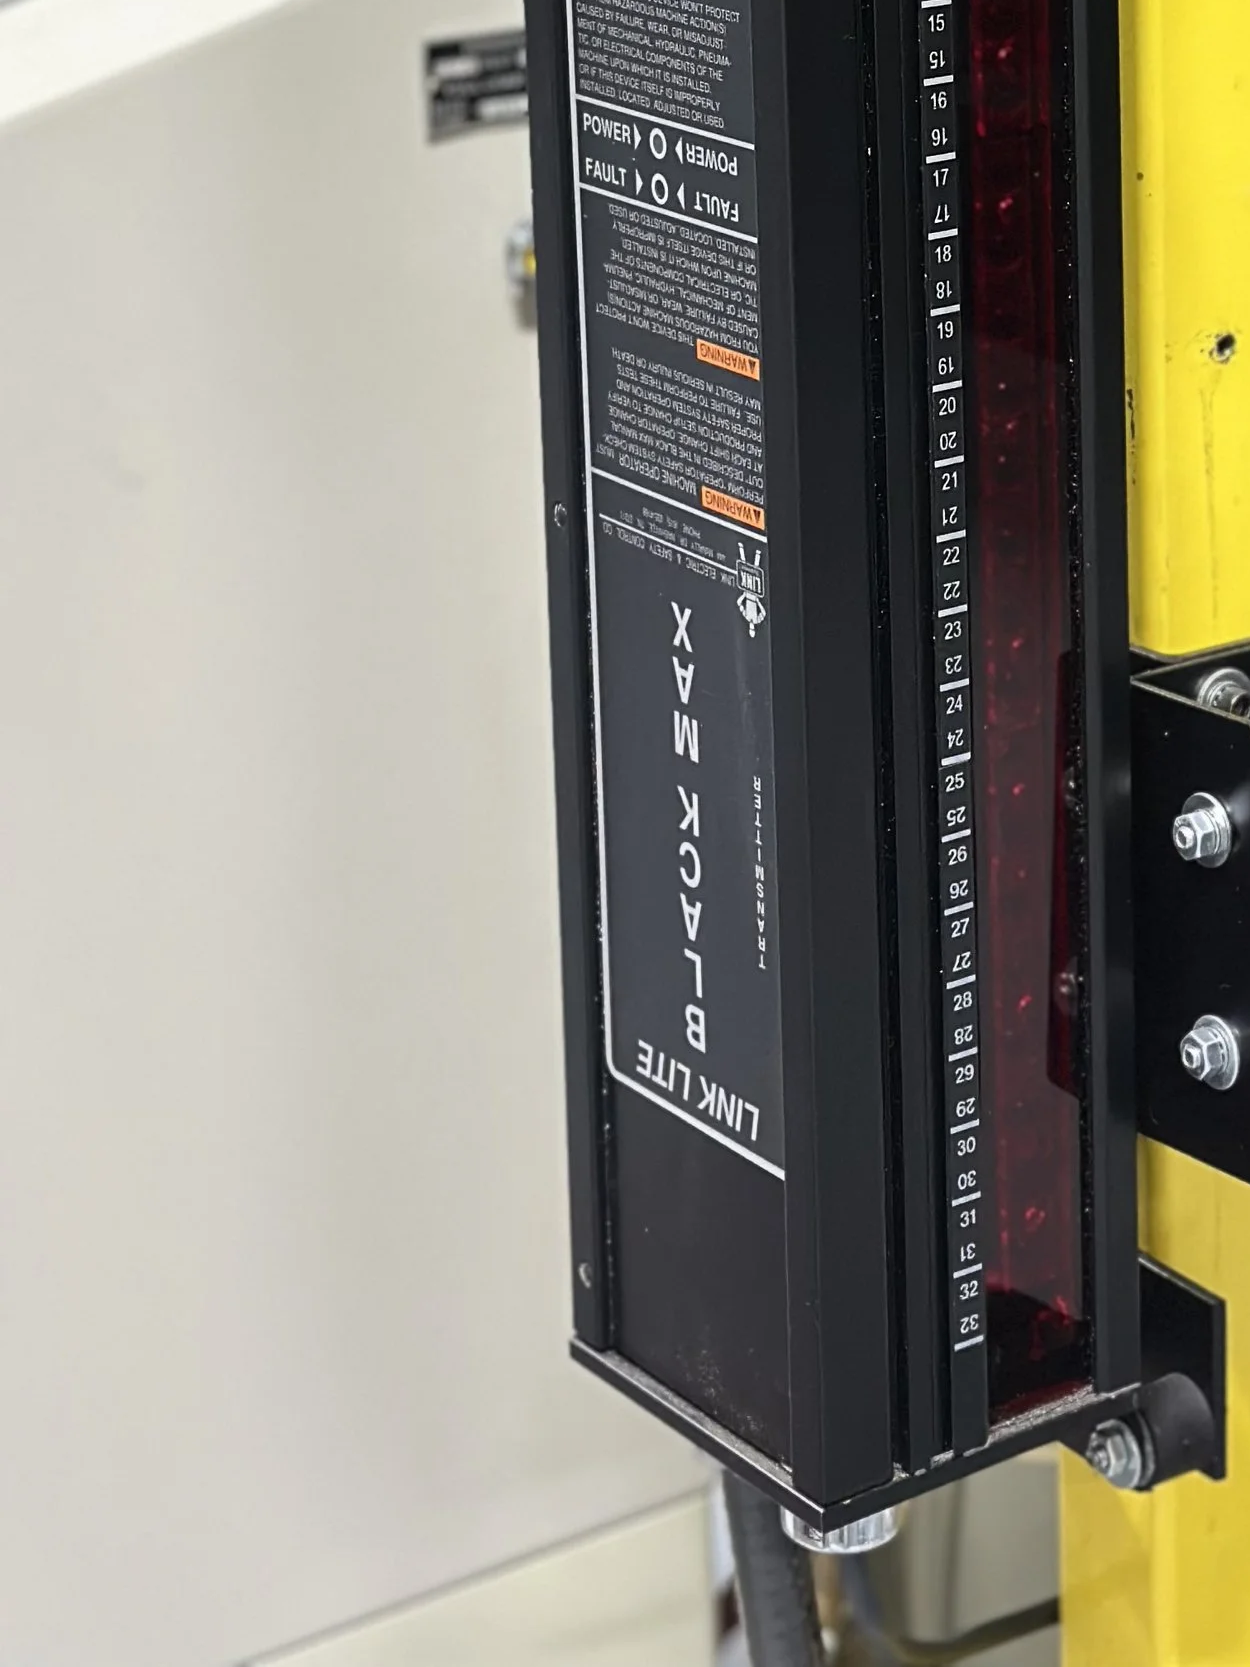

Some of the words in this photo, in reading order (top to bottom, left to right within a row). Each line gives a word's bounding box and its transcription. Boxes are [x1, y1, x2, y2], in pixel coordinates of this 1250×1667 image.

[928, 13, 945, 33] 15
[929, 49, 946, 70] 15
[930, 91, 948, 110] 16
[583, 112, 631, 145] POWER
[931, 127, 948, 147] 16
[685, 141, 738, 177] POWER
[584, 156, 627, 188] FAULT
[932, 167, 949, 188] 17
[693, 189, 739, 223] FAULT
[934, 204, 950, 224] 17
[934, 244, 952, 264] 18
[935, 280, 953, 300] 18
[936, 320, 954, 340] 19
[700, 341, 745, 371] WARNING
[938, 356, 955, 376] 19
[938, 396, 957, 416] 20
[939, 430, 957, 451] 20
[941, 470, 958, 491] 21
[704, 488, 750, 521] WARNING
[942, 505, 958, 527] 21
[942, 545, 961, 566] 22
[943, 580, 961, 601] 22
[944, 620, 962, 641] 23
[945, 654, 963, 675] 23
[670, 600, 699, 764] MAX
[946, 694, 964, 715] 24
[947, 728, 964, 750] 24
[945, 771, 965, 793] 25
[946, 805, 966, 827] 25
[947, 845, 968, 866] 26
[949, 878, 969, 900] 26
[676, 784, 706, 1054] BLACK
[950, 916, 970, 939] 27
[952, 951, 972, 973] 27
[953, 990, 973, 1012] 28
[954, 1024, 974, 1046] 28
[635, 1038, 691, 1102] LITE
[954, 1063, 975, 1084] 29
[696, 1074, 760, 1142] LINK
[955, 1096, 976, 1118] 29
[957, 1135, 977, 1157] 30
[957, 1169, 977, 1191] 30
[959, 1208, 976, 1228] 31
[960, 1242, 976, 1262] 31
[959, 1279, 979, 1301] 32
[960, 1313, 979, 1334] 32
